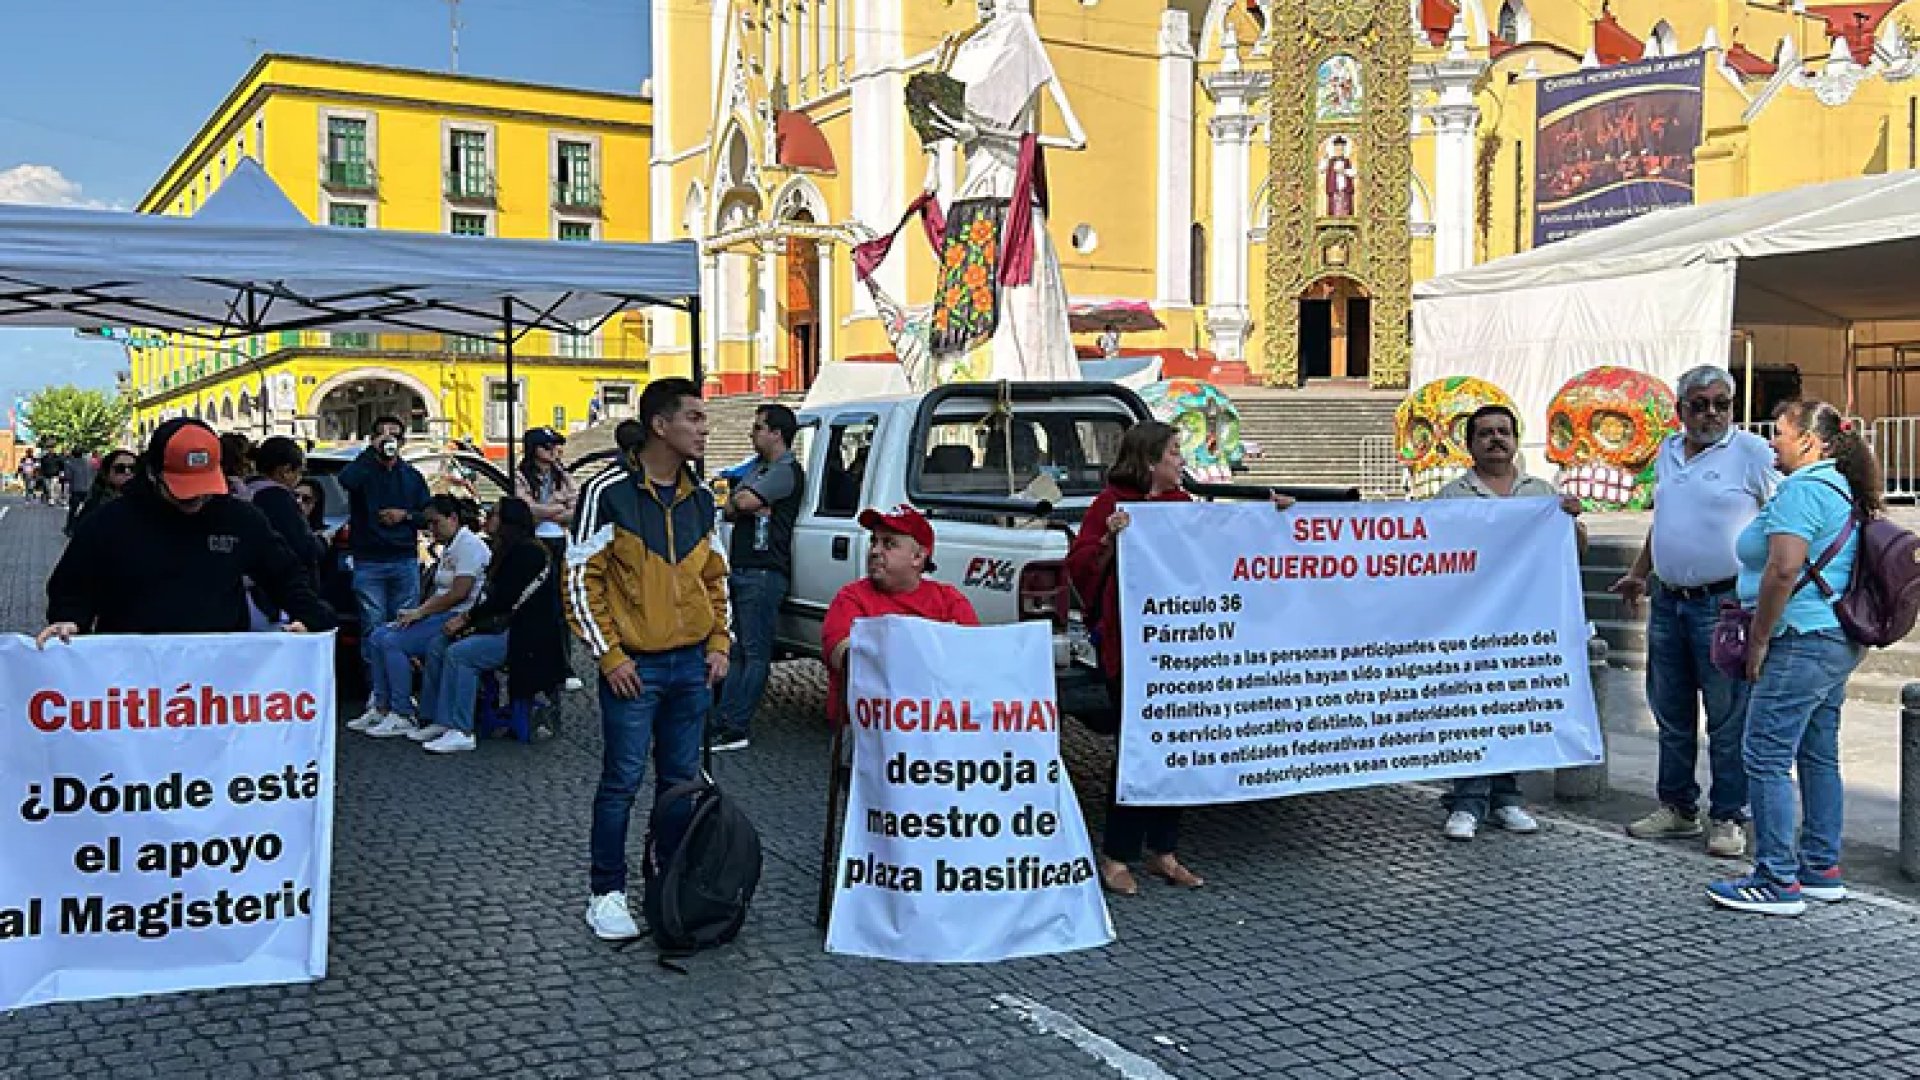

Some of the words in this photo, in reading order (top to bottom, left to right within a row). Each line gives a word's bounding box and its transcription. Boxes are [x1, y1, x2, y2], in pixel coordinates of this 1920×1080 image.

[1293, 517, 1344, 541] SEV
[1350, 516, 1427, 541] VIOLA
[1233, 555, 1358, 581] ACUERDO
[1366, 551, 1477, 577] USICAMM
[1220, 593, 1242, 613] 36
[1143, 621, 1216, 643] Párrafo
[1218, 621, 1235, 640] IV
[1233, 652, 1242, 665] a
[1244, 649, 1267, 664] las
[1270, 647, 1336, 665] personas
[1341, 638, 1435, 660] participantes
[1438, 638, 1468, 655] que
[1470, 632, 1529, 650] derivado
[1531, 629, 1557, 645] del
[1146, 680, 1213, 699] proceso
[1216, 675, 1232, 691] de
[1304, 668, 1348, 686] hayan
[1351, 664, 1383, 681] sido
[1385, 660, 1459, 680] asignadas
[1464, 660, 1471, 673] a
[1474, 657, 1498, 671] una
[1500, 652, 1562, 669] vacante
[28, 683, 316, 732] Cuitláhuac
[855, 698, 981, 733] OFICIAL
[1141, 700, 1221, 720] definitiva
[1223, 703, 1232, 719] y
[1234, 696, 1293, 714] cuenten
[1295, 696, 1311, 712] ya
[1315, 691, 1342, 707] con
[1344, 687, 1376, 704] otra
[1378, 686, 1418, 704] plaza
[1421, 680, 1483, 699] definitiva
[1486, 680, 1506, 692] en
[1507, 678, 1527, 692] un
[1530, 672, 1570, 689] nivel
[1151, 729, 1163, 744] o
[1167, 724, 1232, 743] servicio
[1235, 720, 1303, 737] educativo
[1307, 713, 1367, 732] distinto,
[1371, 710, 1392, 725] las
[1395, 703, 1477, 724] autoridades
[1481, 696, 1565, 716] educativas
[1165, 752, 1188, 768] de
[1192, 750, 1216, 766] las
[1220, 744, 1288, 763] entidades
[1292, 736, 1376, 756] federativas
[1379, 726, 1436, 748] deberán
[1438, 725, 1495, 745] preveer
[1497, 722, 1526, 740] que
[1528, 719, 1553, 734] las
[887, 751, 1037, 792] despoja
[1353, 758, 1388, 773] sean
[20, 773, 214, 821] ¿Dónde
[227, 760, 318, 804] está
[1012, 804, 1056, 837] de
[74, 836, 121, 873] el
[137, 832, 283, 877] apoyo
[842, 852, 922, 892] plaza
[0, 898, 41, 938] al
